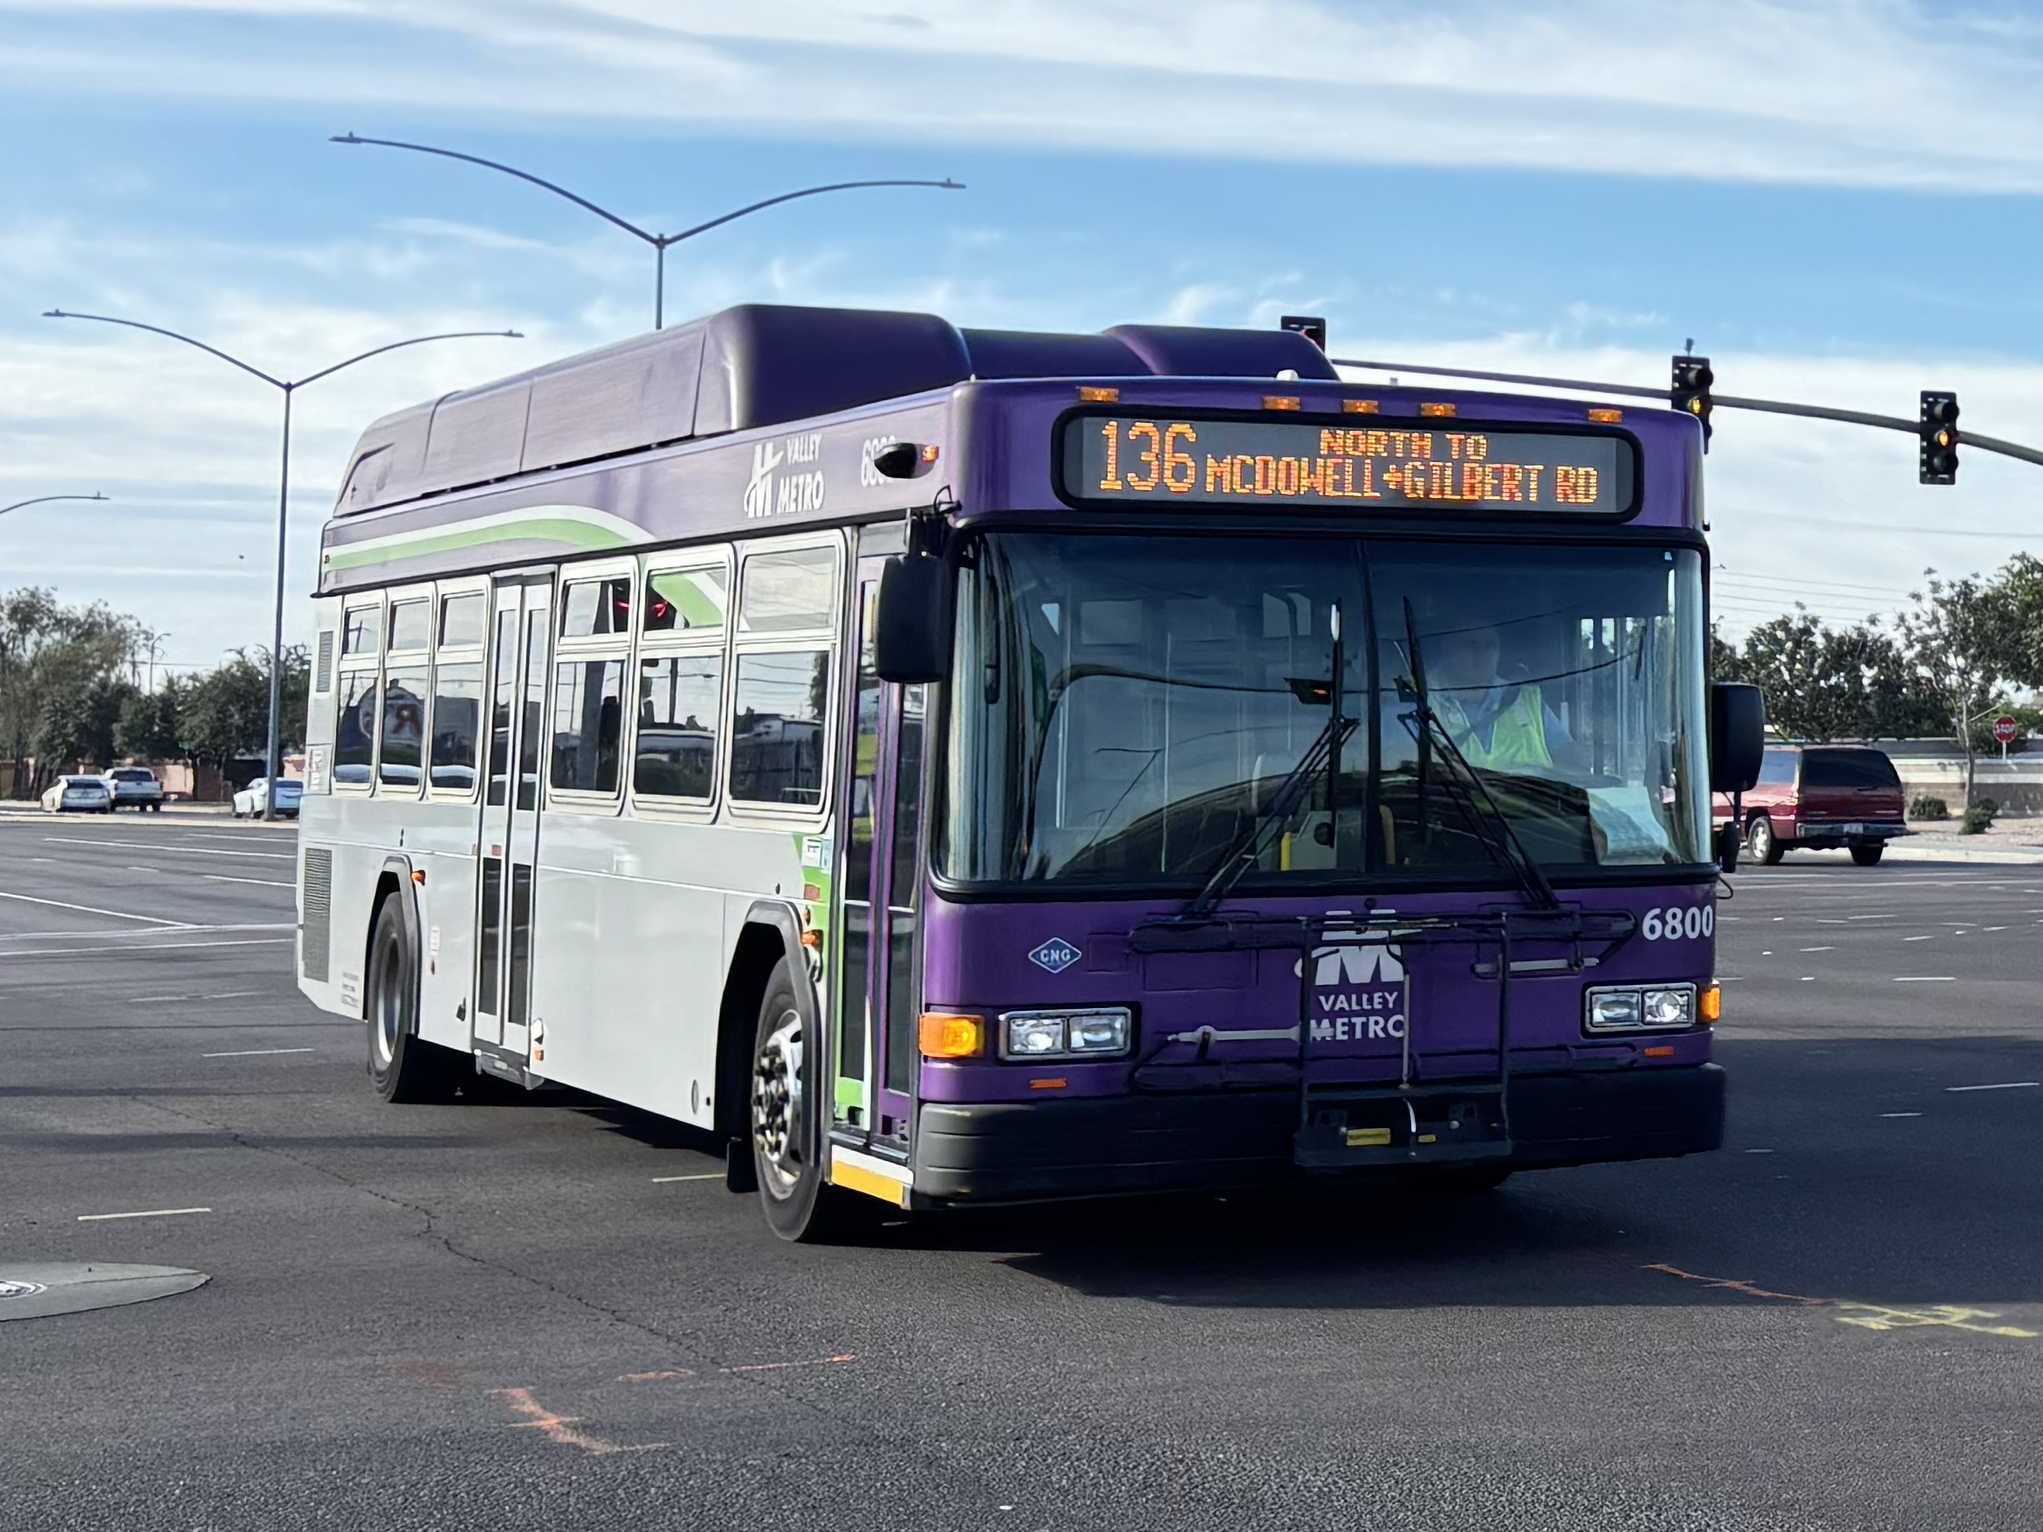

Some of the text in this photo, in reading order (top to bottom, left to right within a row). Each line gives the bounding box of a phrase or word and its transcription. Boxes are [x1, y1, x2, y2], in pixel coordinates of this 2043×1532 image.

[786, 433, 822, 464] VALLEY
[1100, 420, 1198, 493] 136
[1320, 429, 1487, 460] NORTH TO
[776, 470, 825, 514] METRO
[1556, 466, 1598, 504] RD
[1642, 904, 1714, 940] 6800
[1040, 949, 1071, 962] CNG
[1318, 991, 1398, 1011] VALLEY
